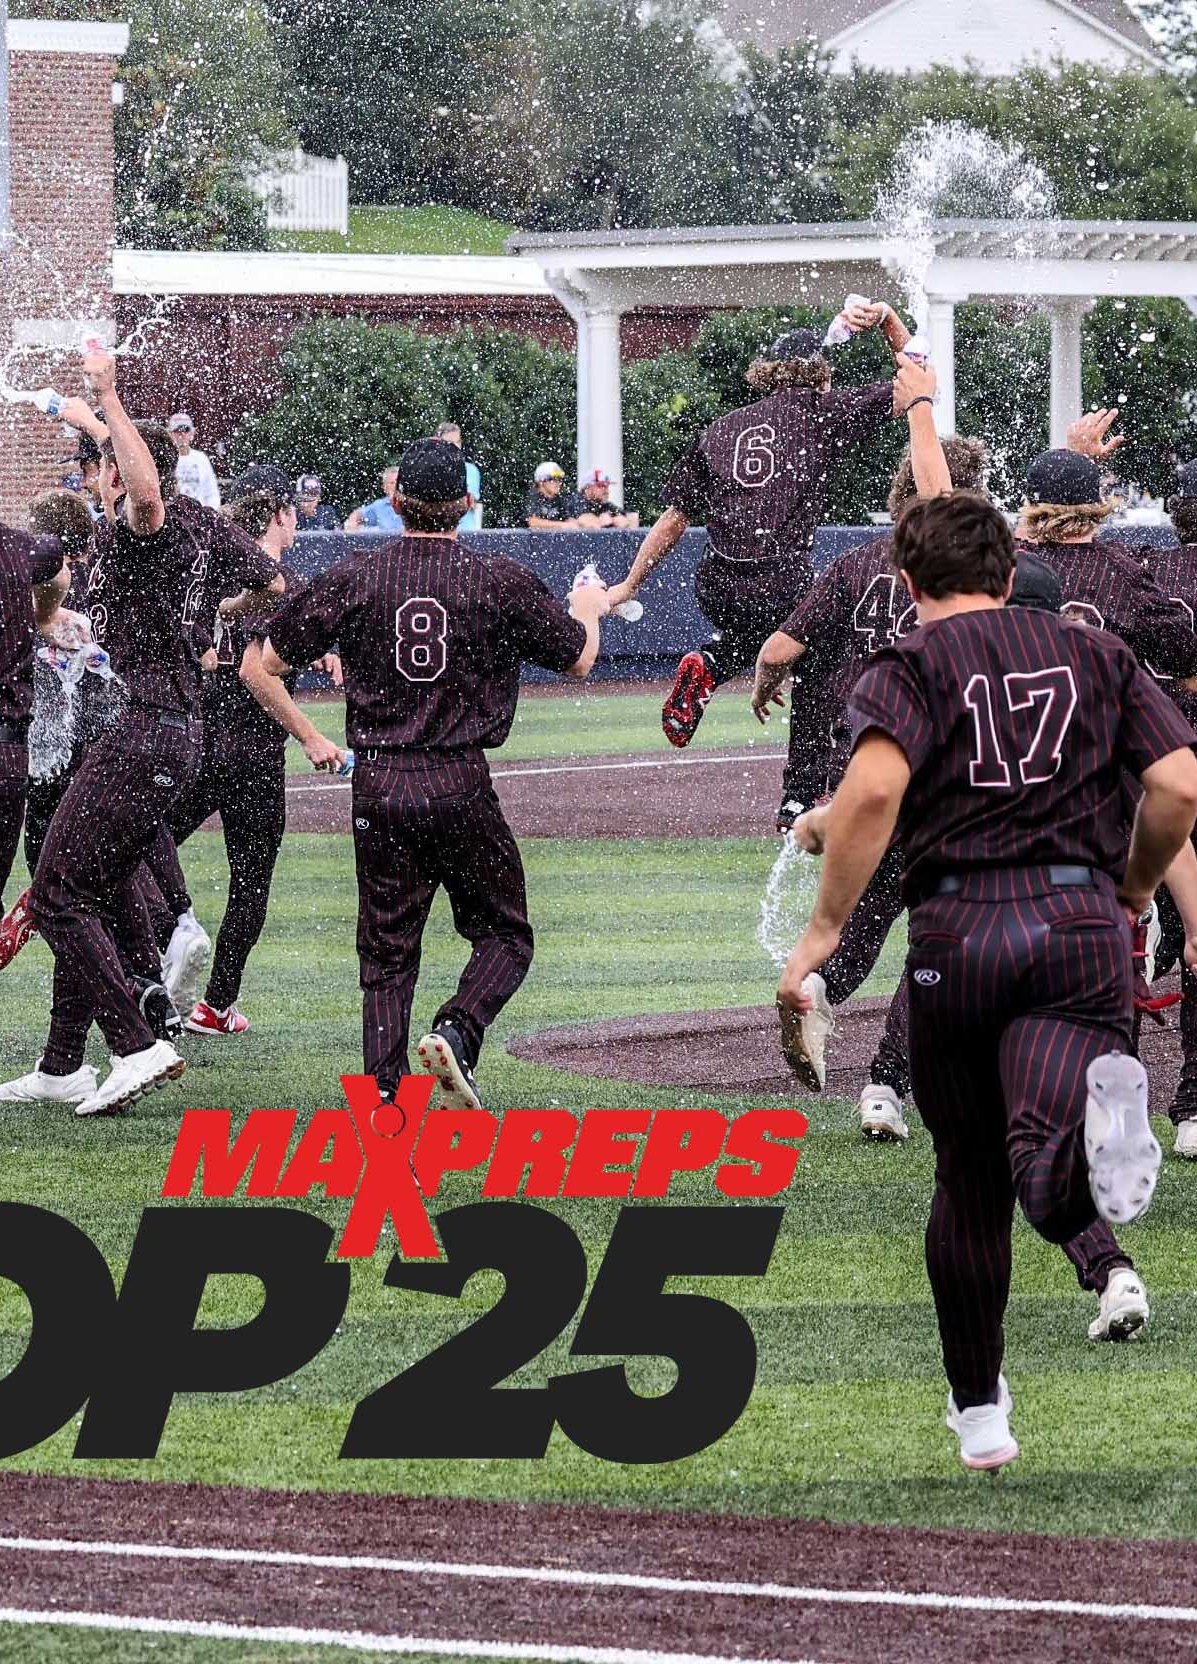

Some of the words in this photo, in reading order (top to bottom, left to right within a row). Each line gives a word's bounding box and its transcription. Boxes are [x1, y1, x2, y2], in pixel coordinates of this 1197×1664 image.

[733, 423, 776, 488] 6
[395, 597, 447, 682] 8
[963, 666, 1078, 788] 17
